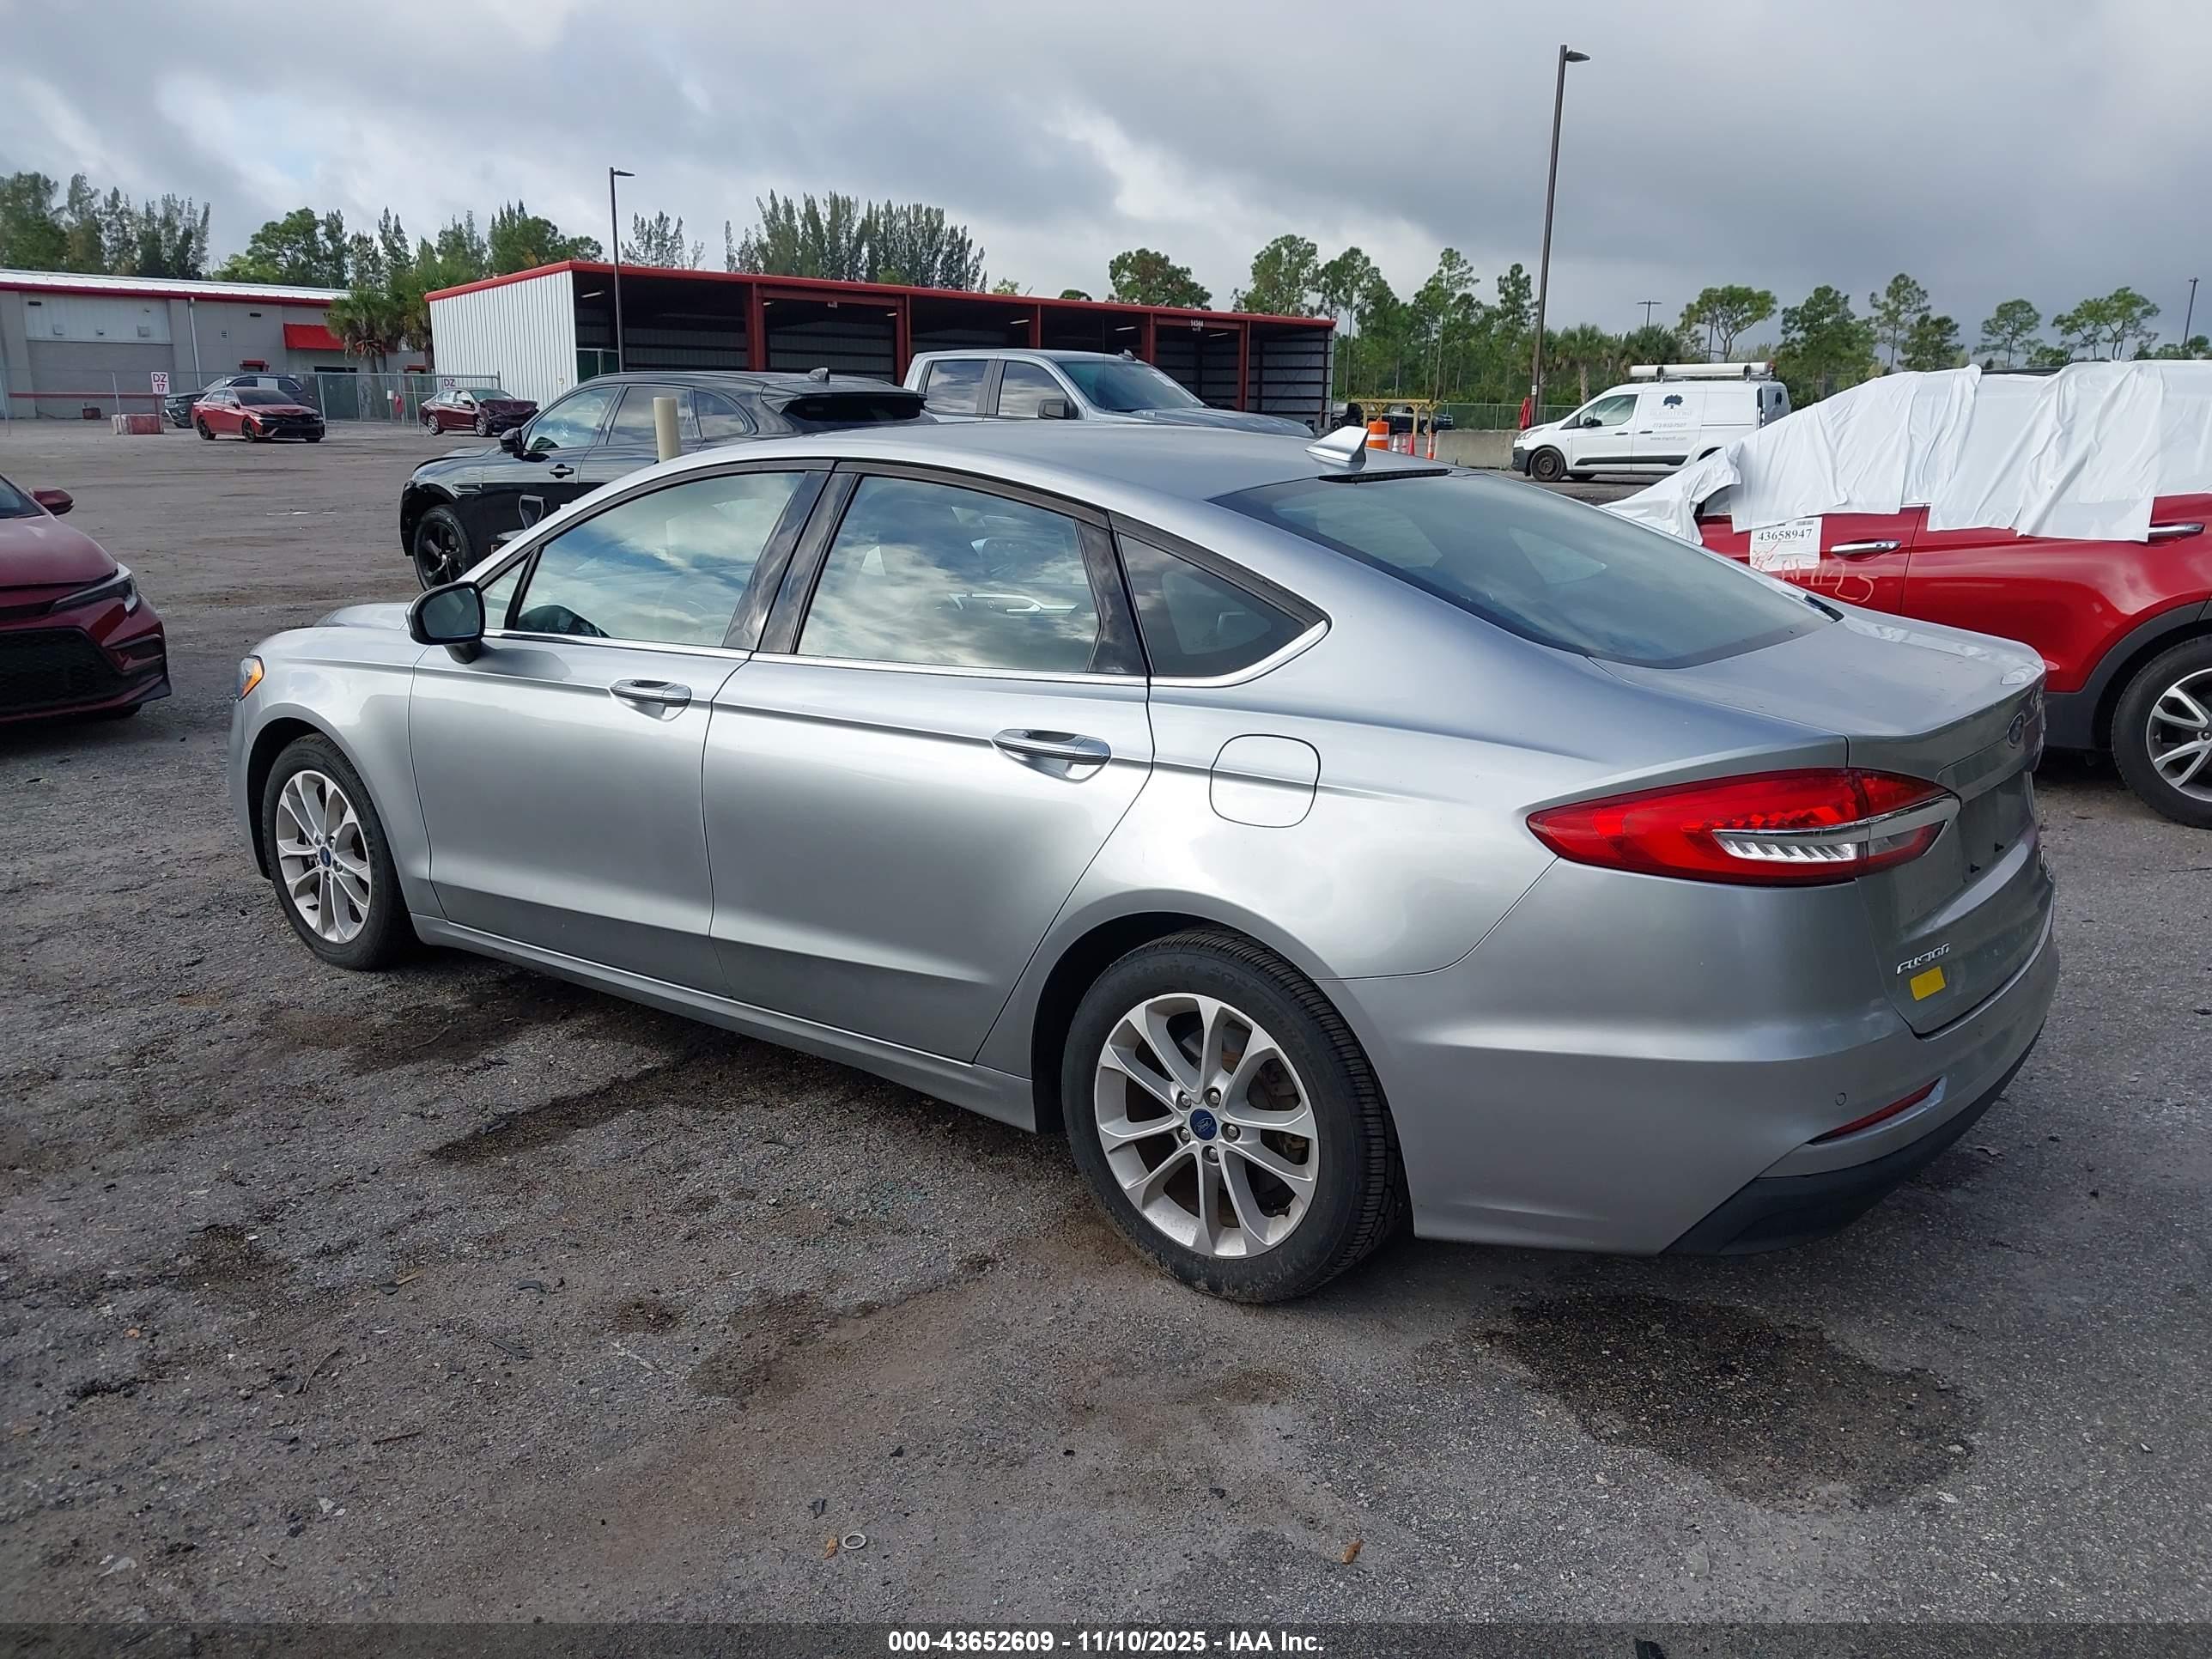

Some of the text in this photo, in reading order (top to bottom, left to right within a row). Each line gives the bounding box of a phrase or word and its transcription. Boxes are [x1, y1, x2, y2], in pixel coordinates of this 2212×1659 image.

[153, 374, 167, 383] DZ
[444, 378, 455, 386] DZ
[156, 383, 166, 392] 17
[1758, 528, 1813, 542] 43658947
[1896, 943, 1950, 975] FUSION
